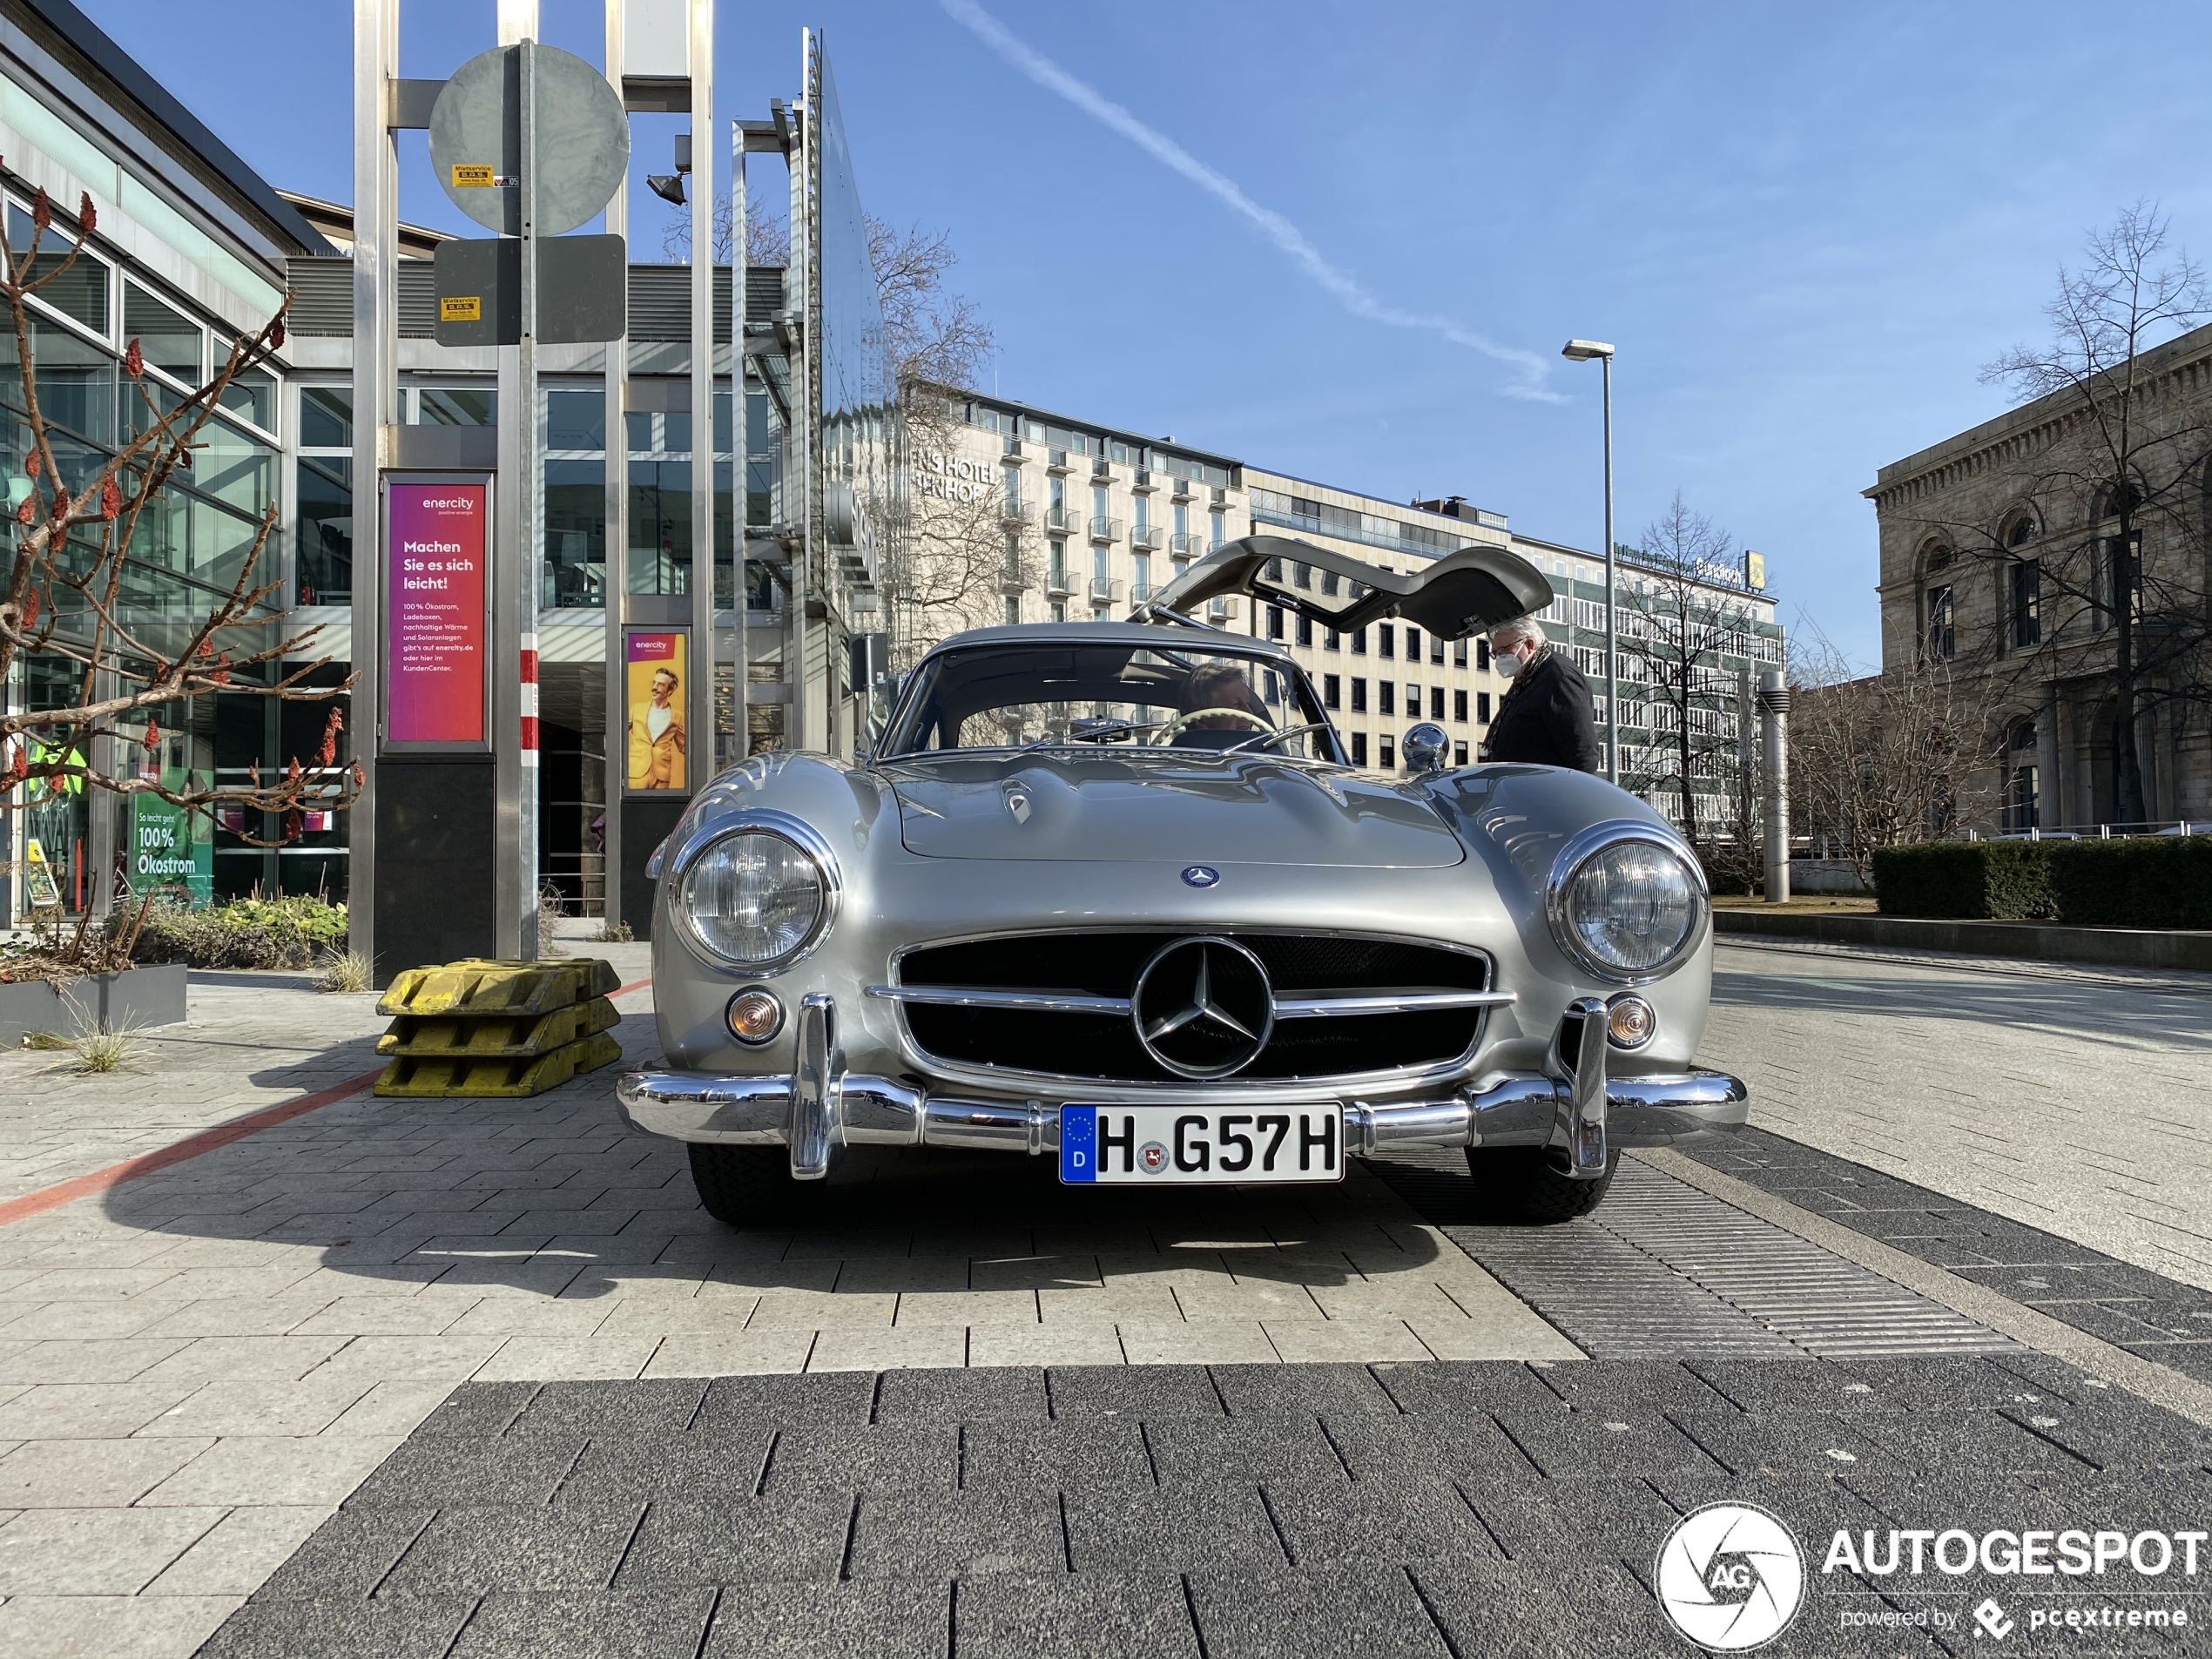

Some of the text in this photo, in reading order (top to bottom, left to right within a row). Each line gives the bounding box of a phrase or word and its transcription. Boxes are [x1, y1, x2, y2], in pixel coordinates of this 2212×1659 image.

[945, 454, 996, 485] HOTEL
[422, 496, 474, 510] enercity
[403, 540, 461, 553] Machen
[403, 558, 474, 571] Sie es sich
[403, 577, 448, 590] leicht!
[425, 602, 459, 610] Ökostrom,
[403, 624, 443, 632] nachhaltige
[635, 641, 667, 650] enercity
[139, 813, 175, 825] So leicht geht
[138, 849, 196, 874] Ökostrom
[1098, 1115, 1134, 1172] H
[1073, 1151, 1086, 1167] D
